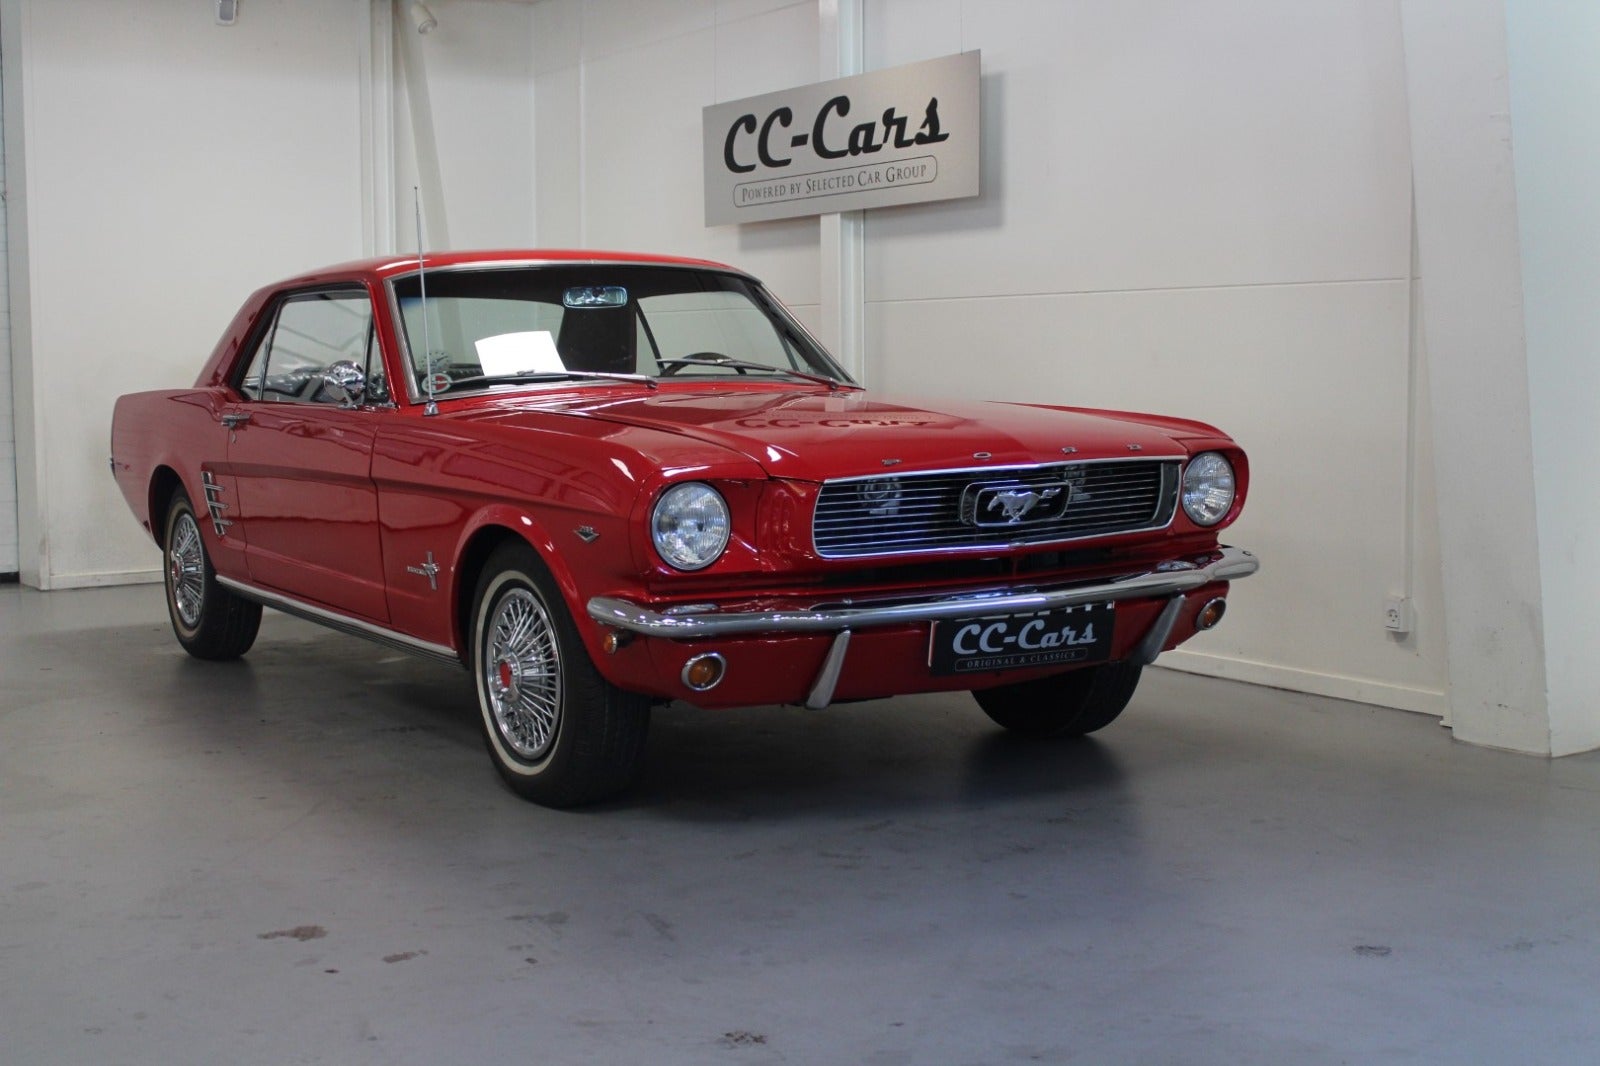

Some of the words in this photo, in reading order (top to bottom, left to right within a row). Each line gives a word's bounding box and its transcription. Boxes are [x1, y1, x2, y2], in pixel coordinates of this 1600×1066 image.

[724, 95, 950, 174] CC-Cars
[742, 184, 786, 202] POWERED
[790, 183, 801, 196] BY
[806, 175, 855, 194] SELECTED
[858, 170, 881, 187] CAR
[886, 164, 927, 183] GROUP
[953, 619, 1097, 655] CC-Cars
[967, 657, 1015, 668] ORIGINAL
[1030, 651, 1077, 663] CLASSICS
